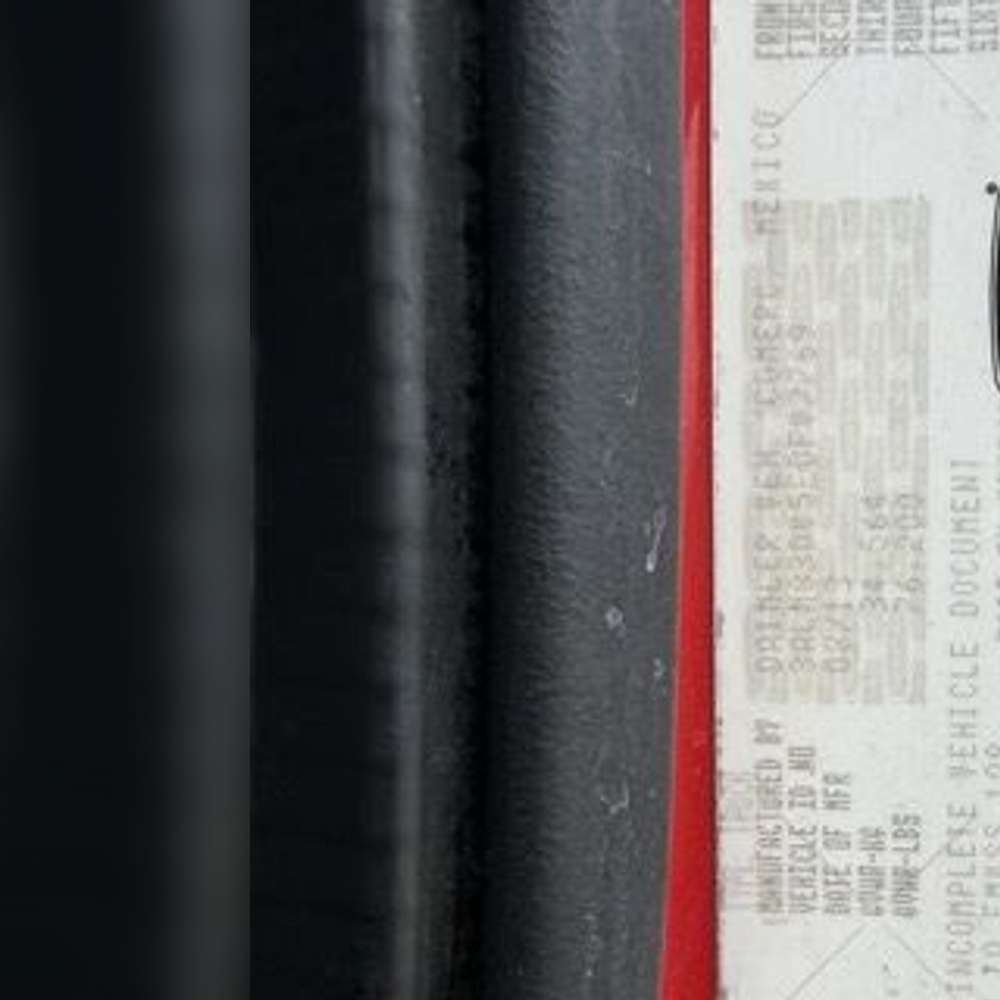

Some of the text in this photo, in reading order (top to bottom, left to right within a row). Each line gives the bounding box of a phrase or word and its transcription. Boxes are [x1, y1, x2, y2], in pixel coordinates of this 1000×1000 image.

[751, 108, 782, 237] MEXICO
[754, 533, 783, 674] DAIMLER
[949, 455, 981, 617] DOCUMENT
[948, 640, 979, 778] VEHICLE
[755, 718, 783, 914] MANUFACTURED BY
[789, 824, 817, 914] VEHICLE
[822, 772, 851, 914] DATE OF MFR
[946, 802, 978, 995] INCOMPLETE
